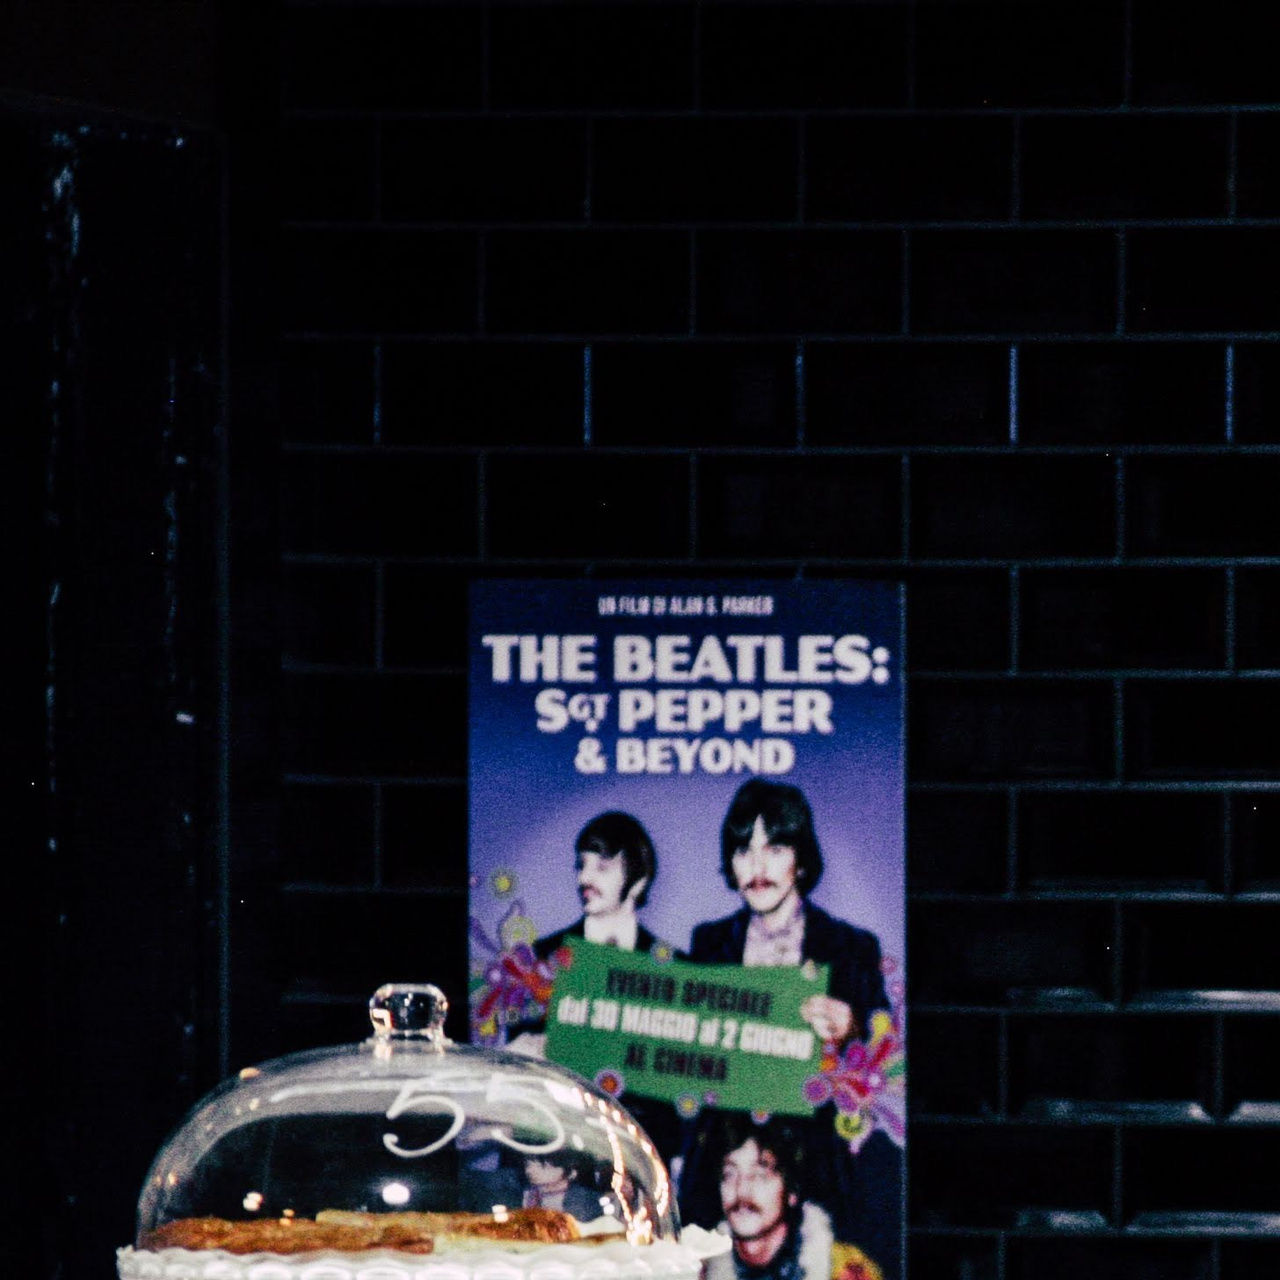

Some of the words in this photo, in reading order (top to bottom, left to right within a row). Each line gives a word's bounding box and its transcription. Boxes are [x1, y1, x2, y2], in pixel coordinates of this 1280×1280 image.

[482, 634, 597, 683] THE
[613, 633, 890, 685] BEATLES:
[618, 689, 834, 733] PEPPER
[574, 737, 607, 774] &
[616, 738, 796, 774] BEYOND
